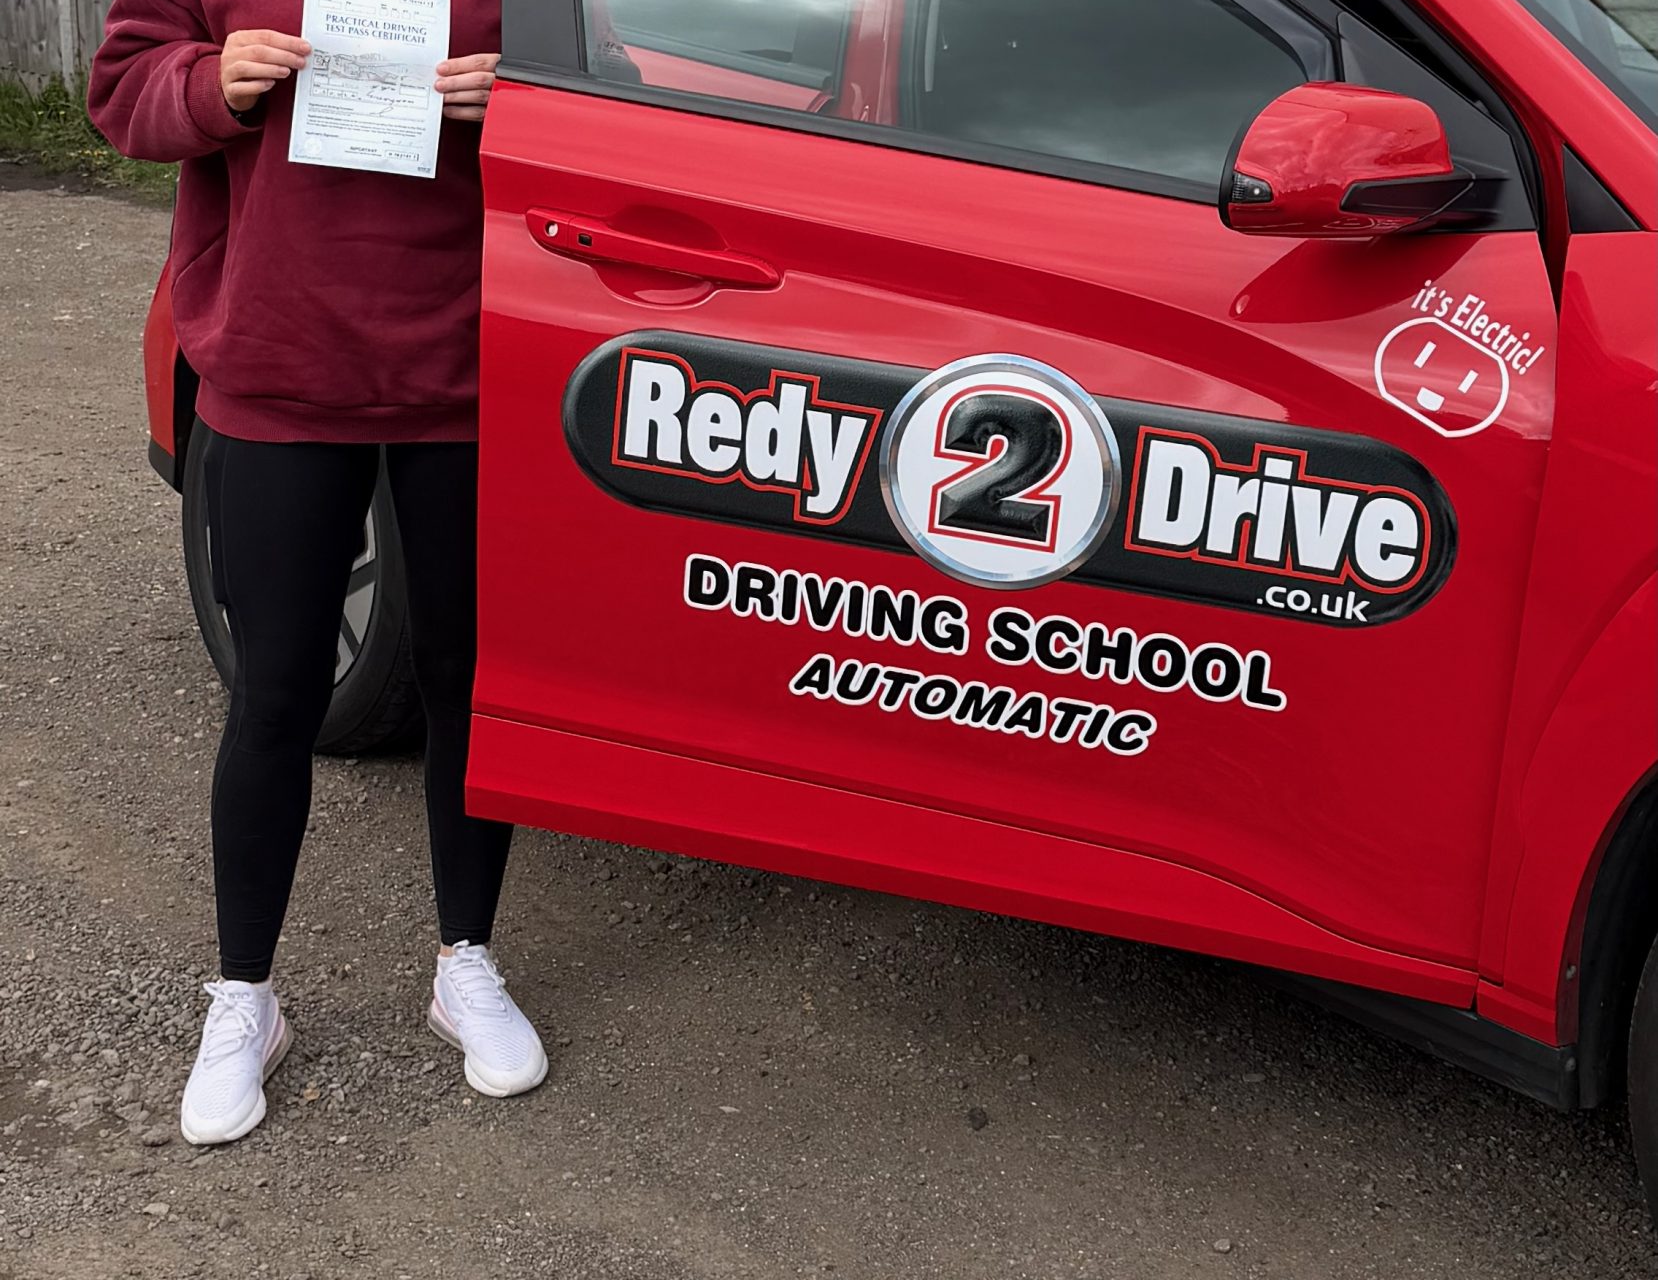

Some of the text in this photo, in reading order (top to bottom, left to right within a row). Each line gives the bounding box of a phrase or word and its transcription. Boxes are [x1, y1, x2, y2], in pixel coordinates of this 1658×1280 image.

[325, 23, 427, 44] TEST PASS CERTIFICATE
[326, 13, 428, 36] PRACTICAL DRIVING
[1411, 279, 1545, 376] it's Electric!
[622, 357, 1419, 582] Redy 2 Drive
[685, 555, 1287, 711] DRIVING SCHOOL
[1255, 586, 1370, 622] .co.uk
[790, 652, 1157, 755] AUTOMATIC
